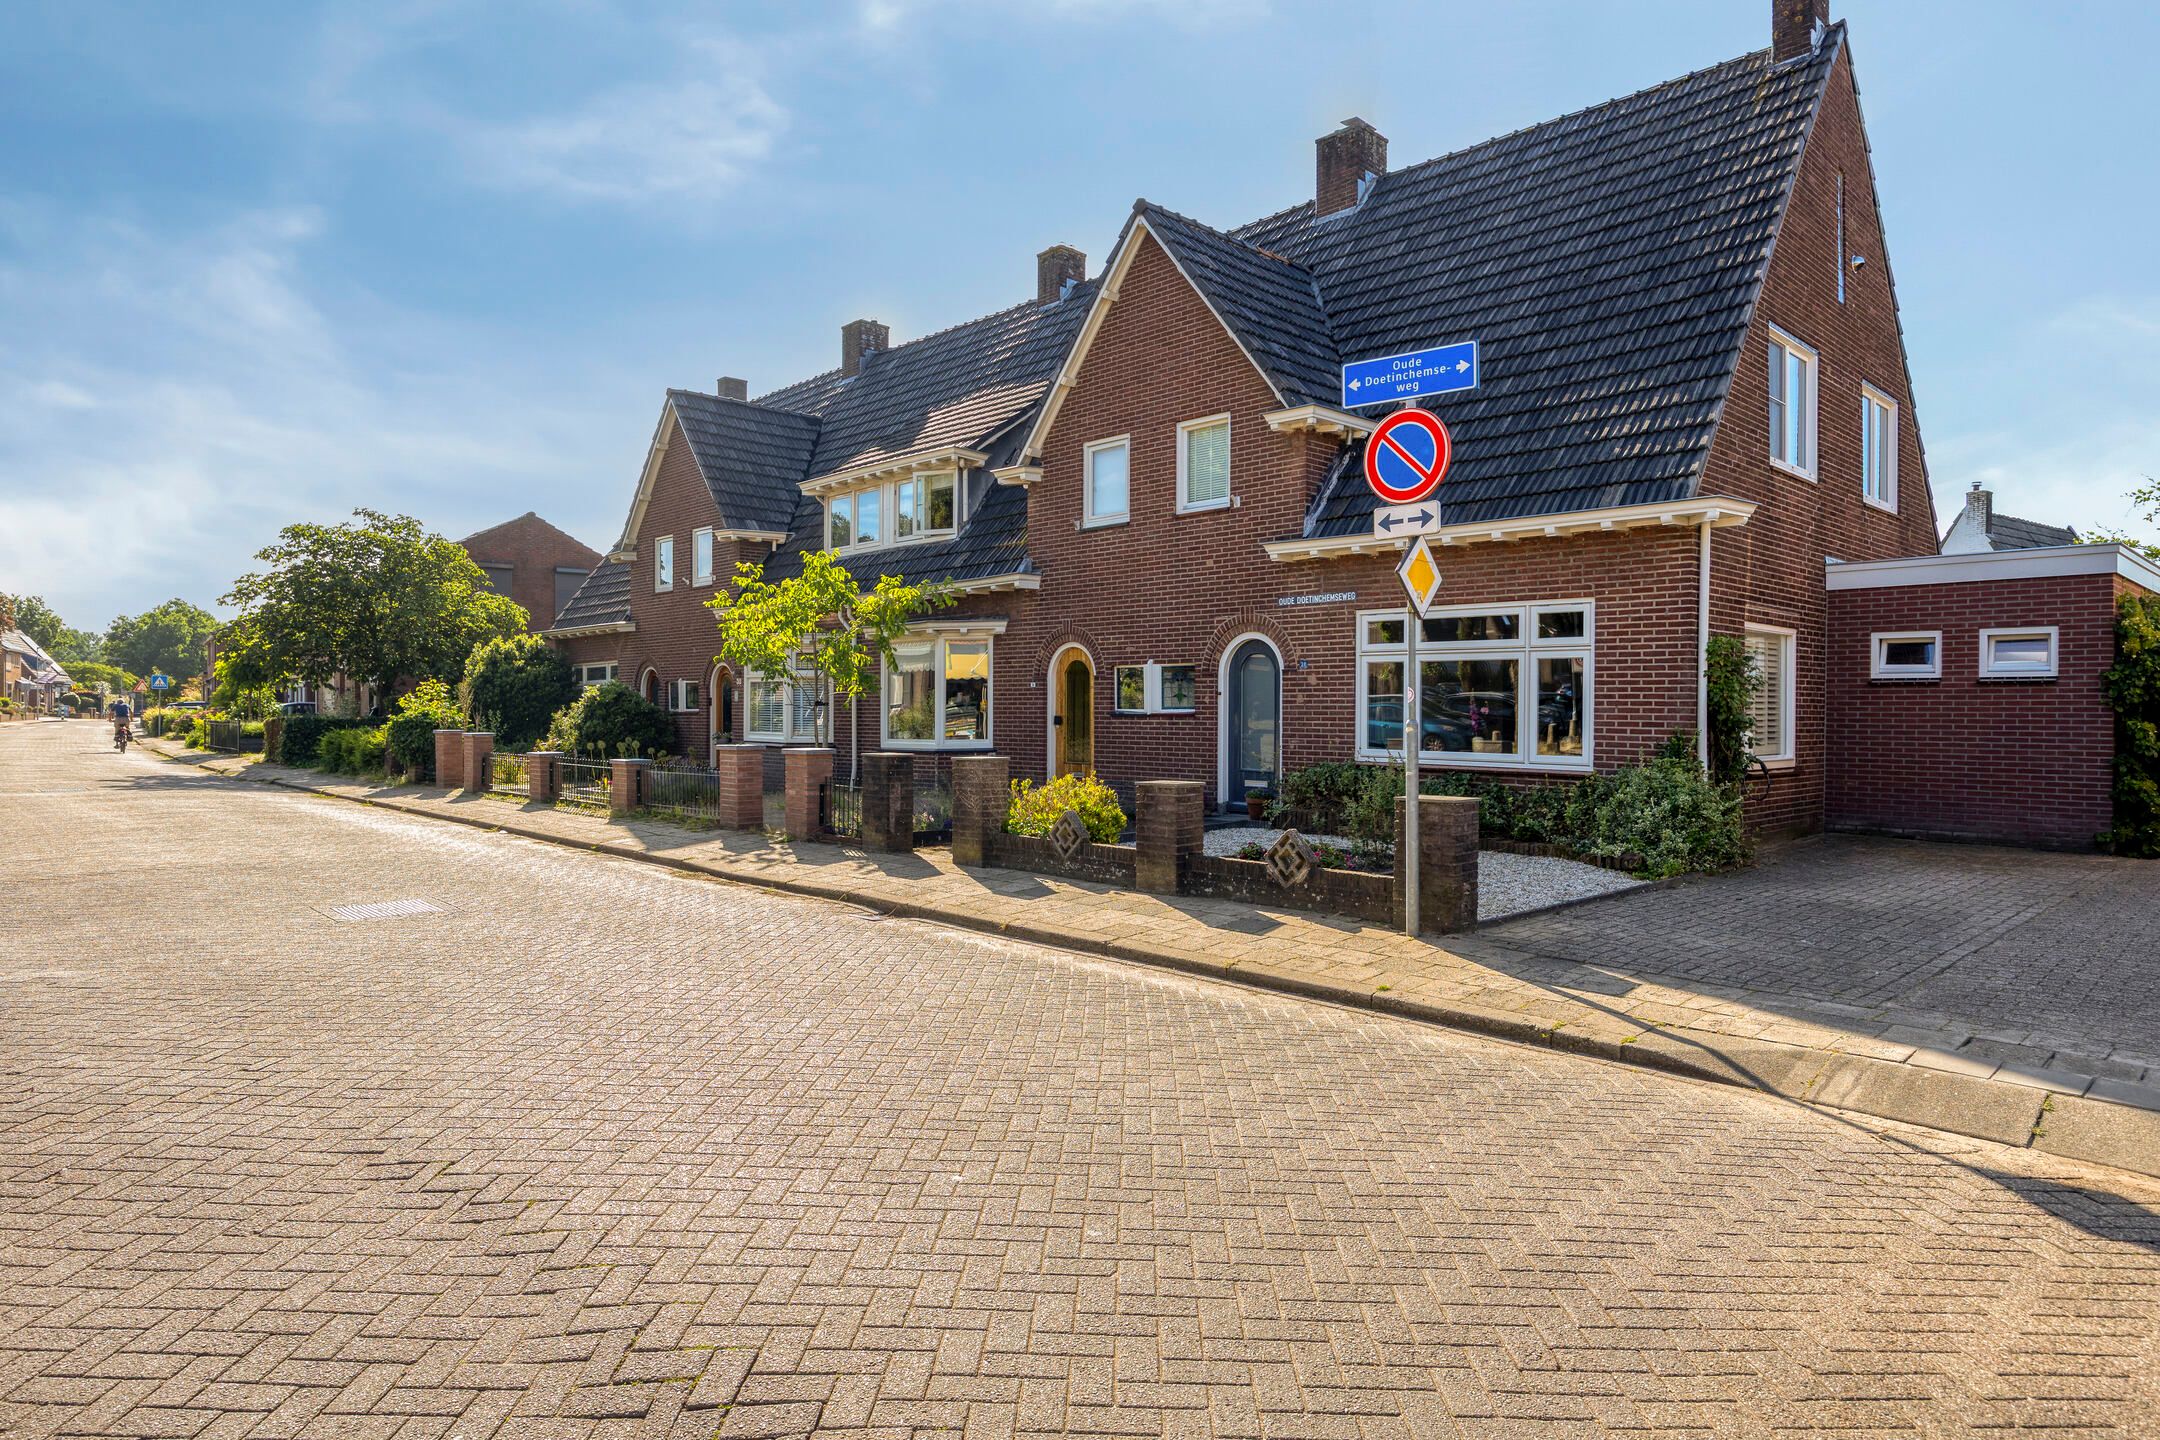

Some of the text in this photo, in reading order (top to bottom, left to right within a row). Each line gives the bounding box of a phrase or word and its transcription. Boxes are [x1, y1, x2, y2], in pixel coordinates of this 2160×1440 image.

[1392, 357, 1422, 371] Oude
[1365, 366, 1451, 387] Doetinchemse-
[1396, 381, 1419, 393] weg
[1278, 592, 1356, 606] OUDE DOETINCHEMSEWEG
